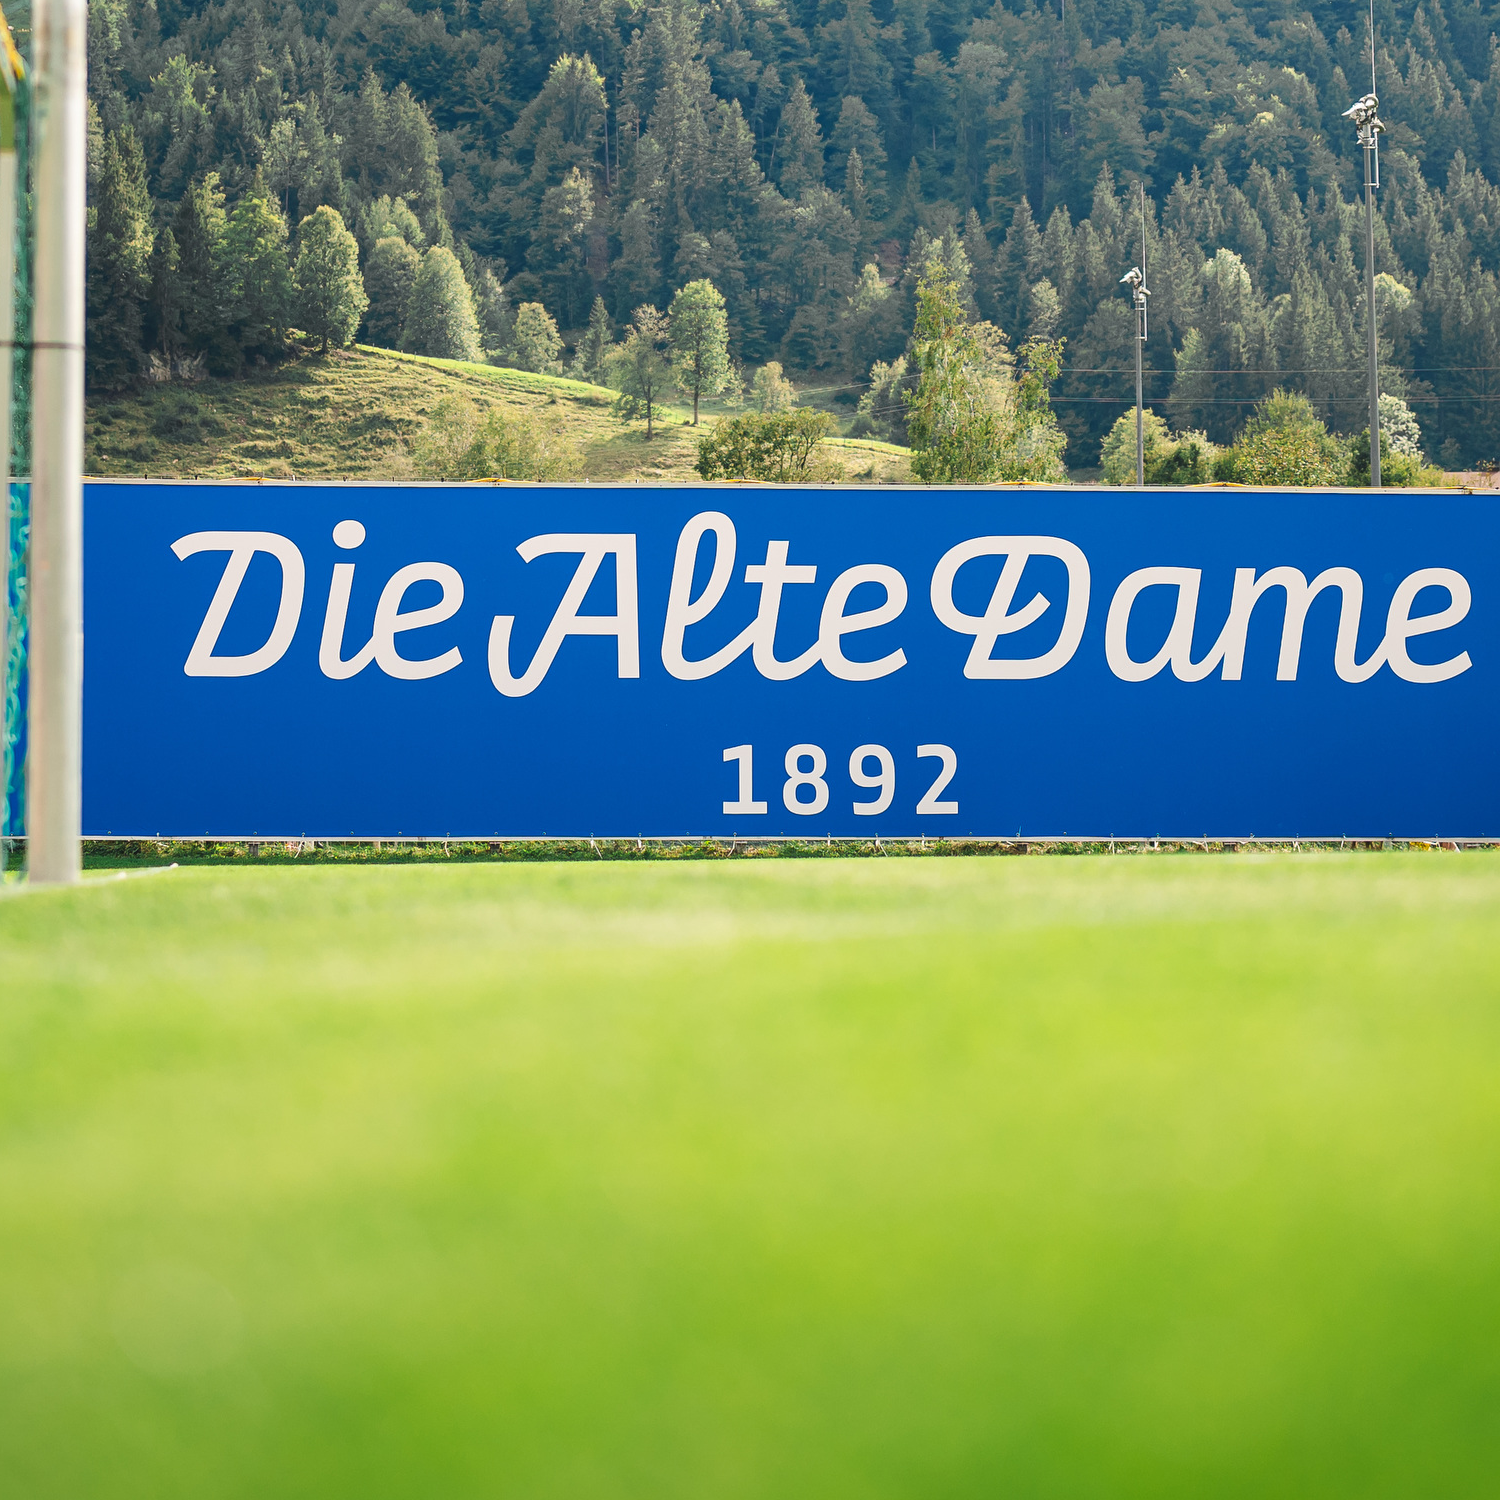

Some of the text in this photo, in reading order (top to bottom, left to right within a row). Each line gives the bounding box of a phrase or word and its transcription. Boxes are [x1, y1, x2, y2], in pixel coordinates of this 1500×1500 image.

[169, 510, 1473, 698] Die Alte Dame
[722, 743, 959, 816] 1892
